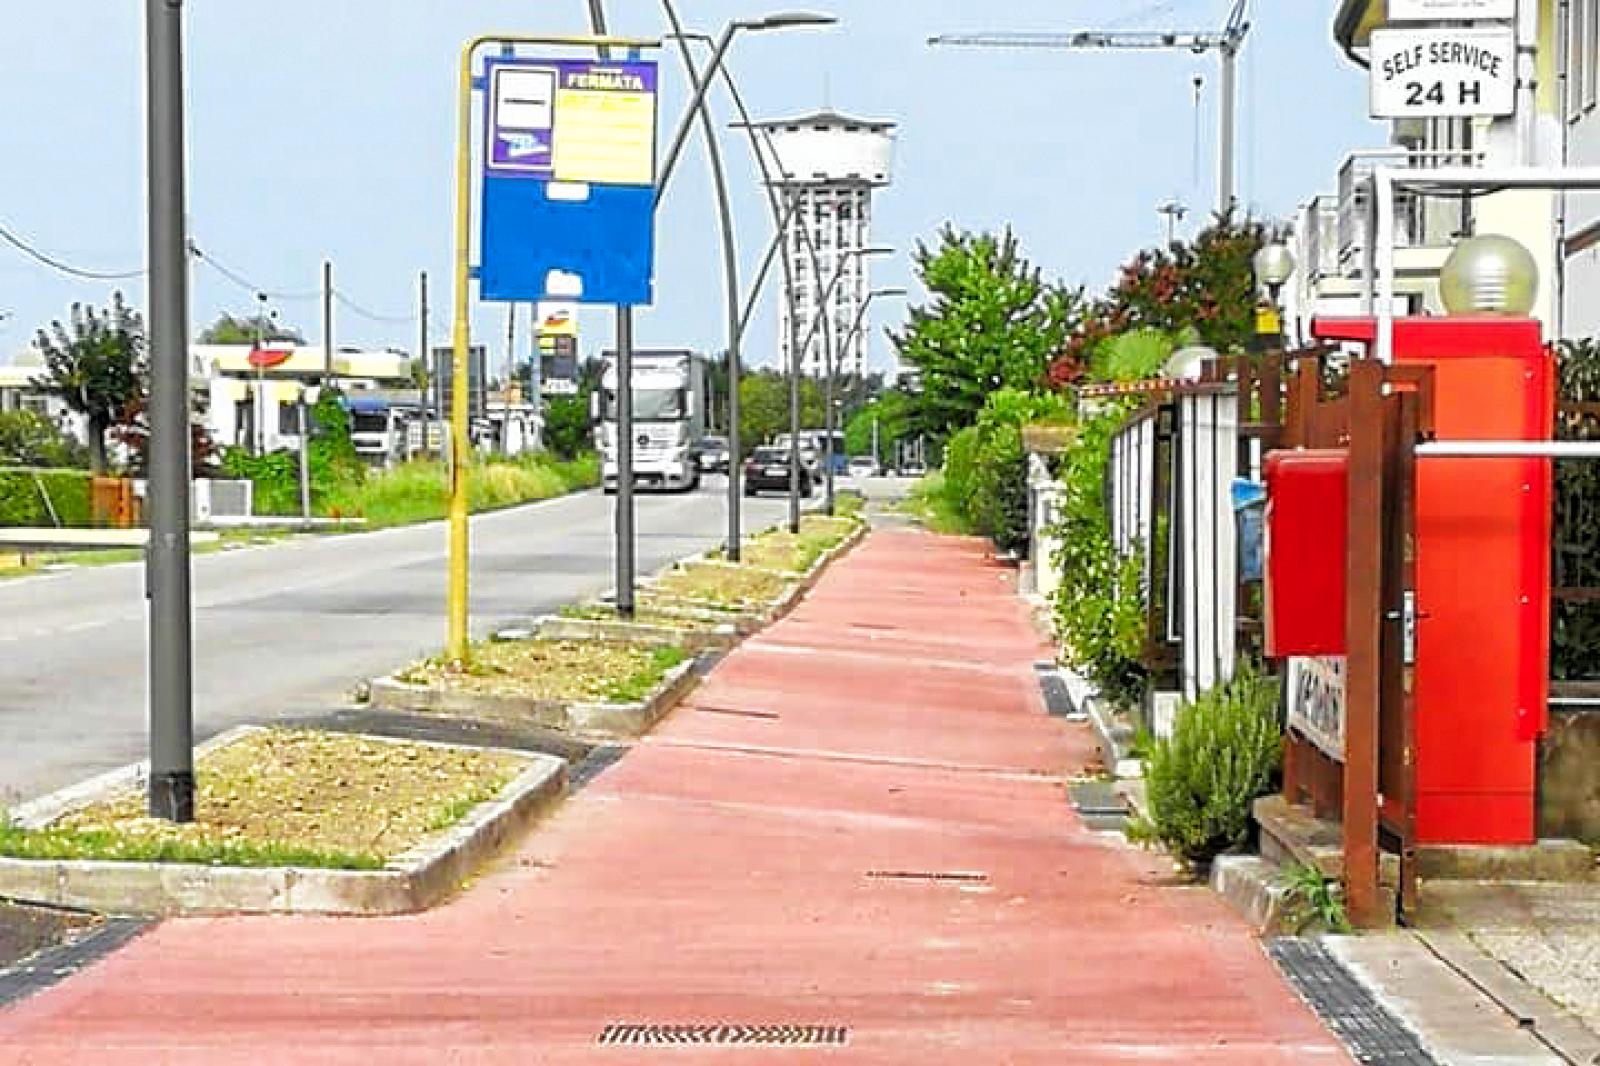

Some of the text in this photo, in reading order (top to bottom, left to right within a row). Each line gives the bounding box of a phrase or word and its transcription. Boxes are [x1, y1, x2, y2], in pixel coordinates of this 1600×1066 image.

[1382, 42, 1502, 80] SELF SERVICE
[568, 73, 643, 89] FERMATA
[1405, 81, 1480, 105] 24 H
